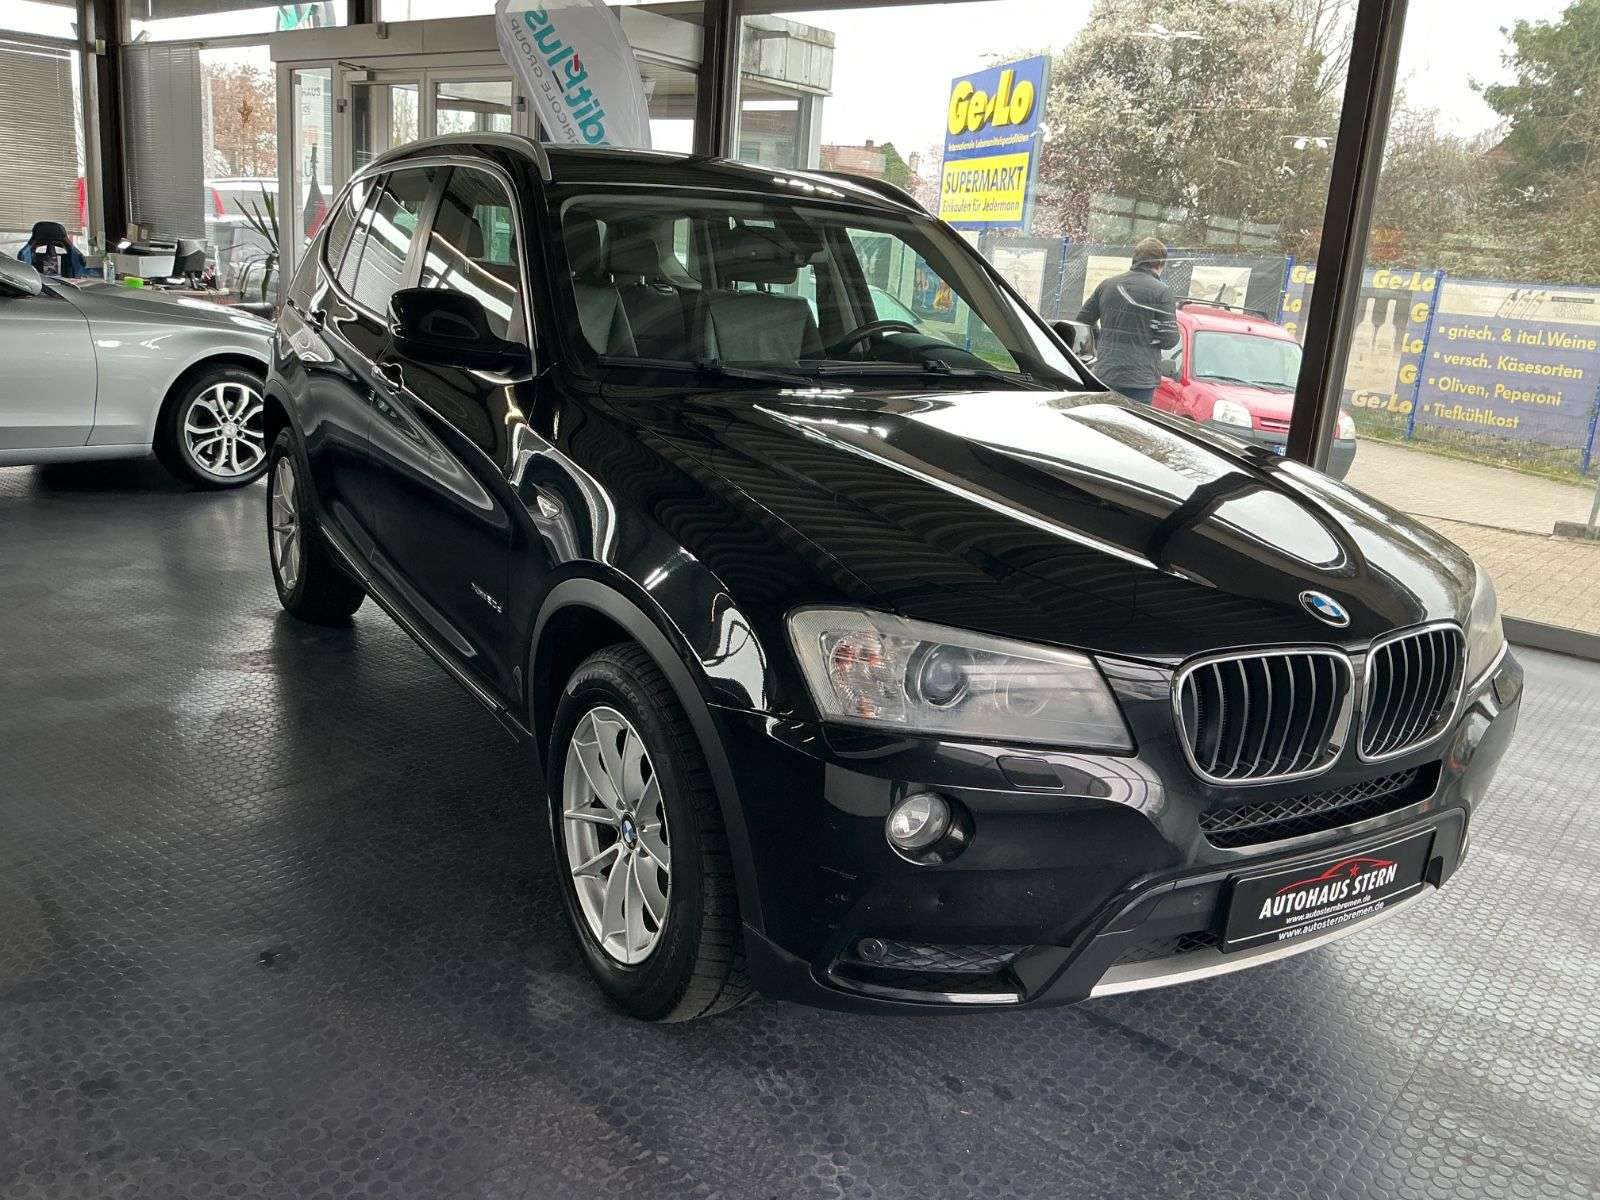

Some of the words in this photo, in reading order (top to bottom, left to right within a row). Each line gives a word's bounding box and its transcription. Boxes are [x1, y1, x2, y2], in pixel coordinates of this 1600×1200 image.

[944, 166, 1024, 194] SUPERMARKT
[982, 197, 1020, 212] Jedermann
[1448, 324, 1496, 341] griech.
[1501, 328, 1512, 344] &
[1516, 329, 1545, 346] ital.
[1547, 331, 1597, 351] Weine
[1443, 353, 1492, 369] versch.
[1497, 355, 1583, 379] Käsesorten
[1438, 376, 1489, 398] Oliven,
[1494, 383, 1562, 406] Peperoni
[1434, 402, 1520, 429] Tiefkühlkost
[1259, 879, 1350, 920] AUTOHAUS
[1352, 863, 1398, 895] STERN
[1278, 901, 1385, 941] www.autosternbremen.de
[1286, 894, 1371, 924] www.autosternbremen.de
